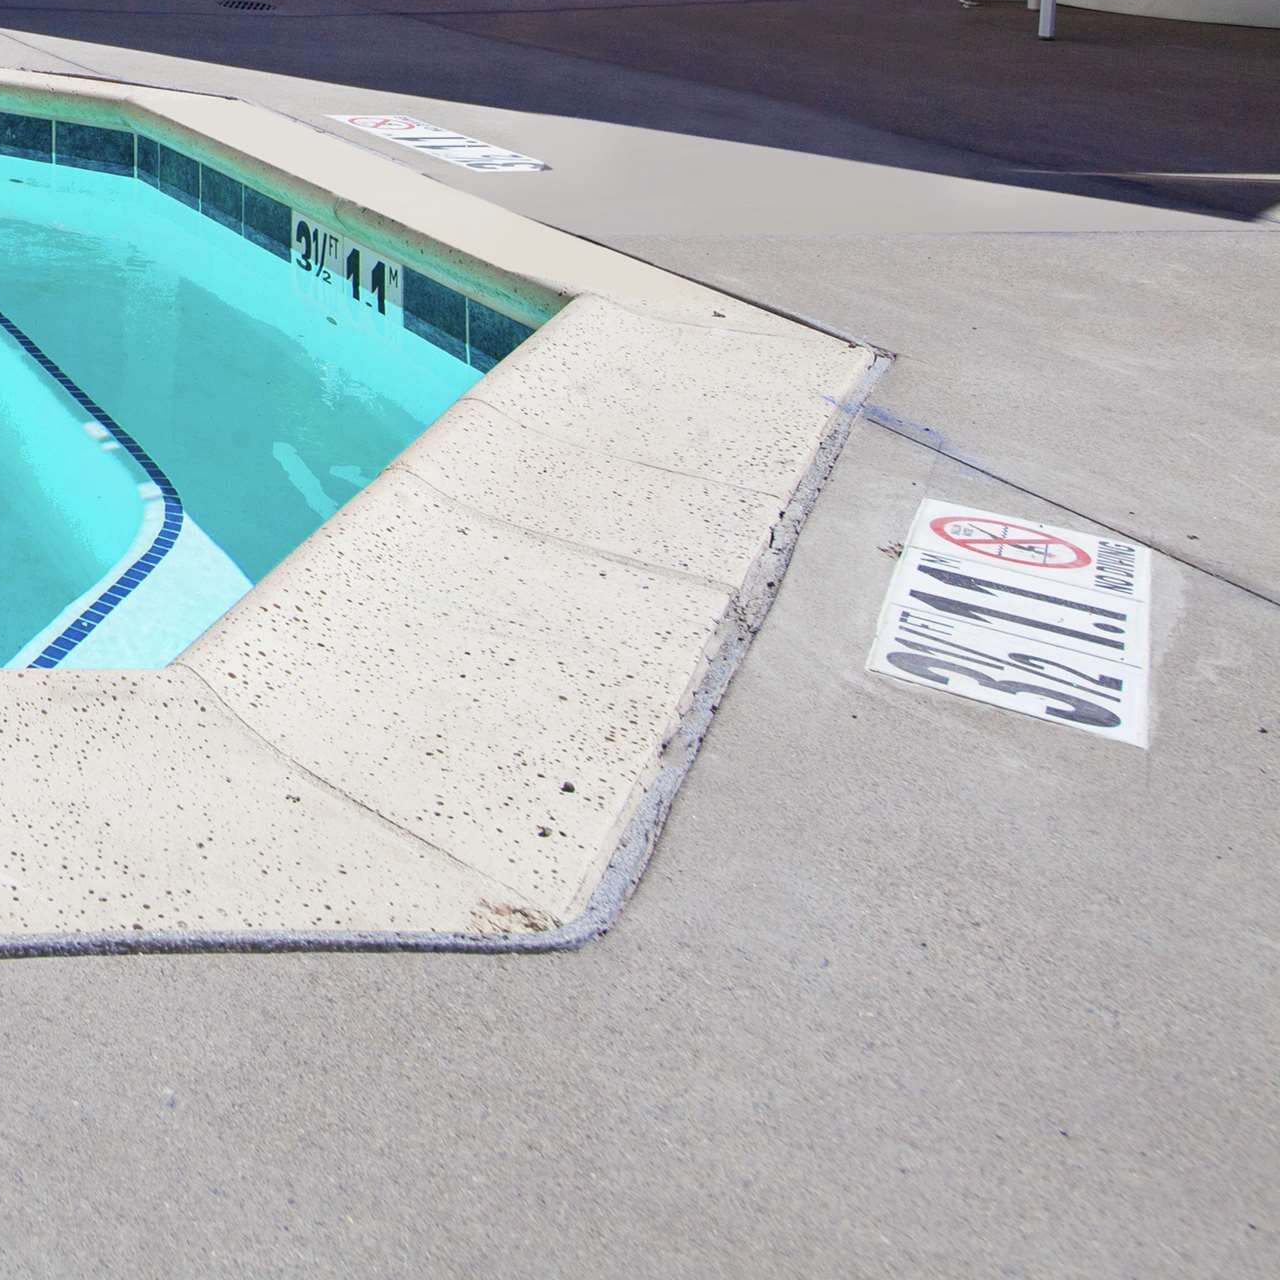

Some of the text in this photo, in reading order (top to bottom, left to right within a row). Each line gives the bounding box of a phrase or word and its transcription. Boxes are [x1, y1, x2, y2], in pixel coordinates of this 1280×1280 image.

[328, 234, 339, 260] FT
[389, 266, 399, 289] M
[908, 564, 1127, 651] 1.1
[1093, 575, 1134, 595] NO
